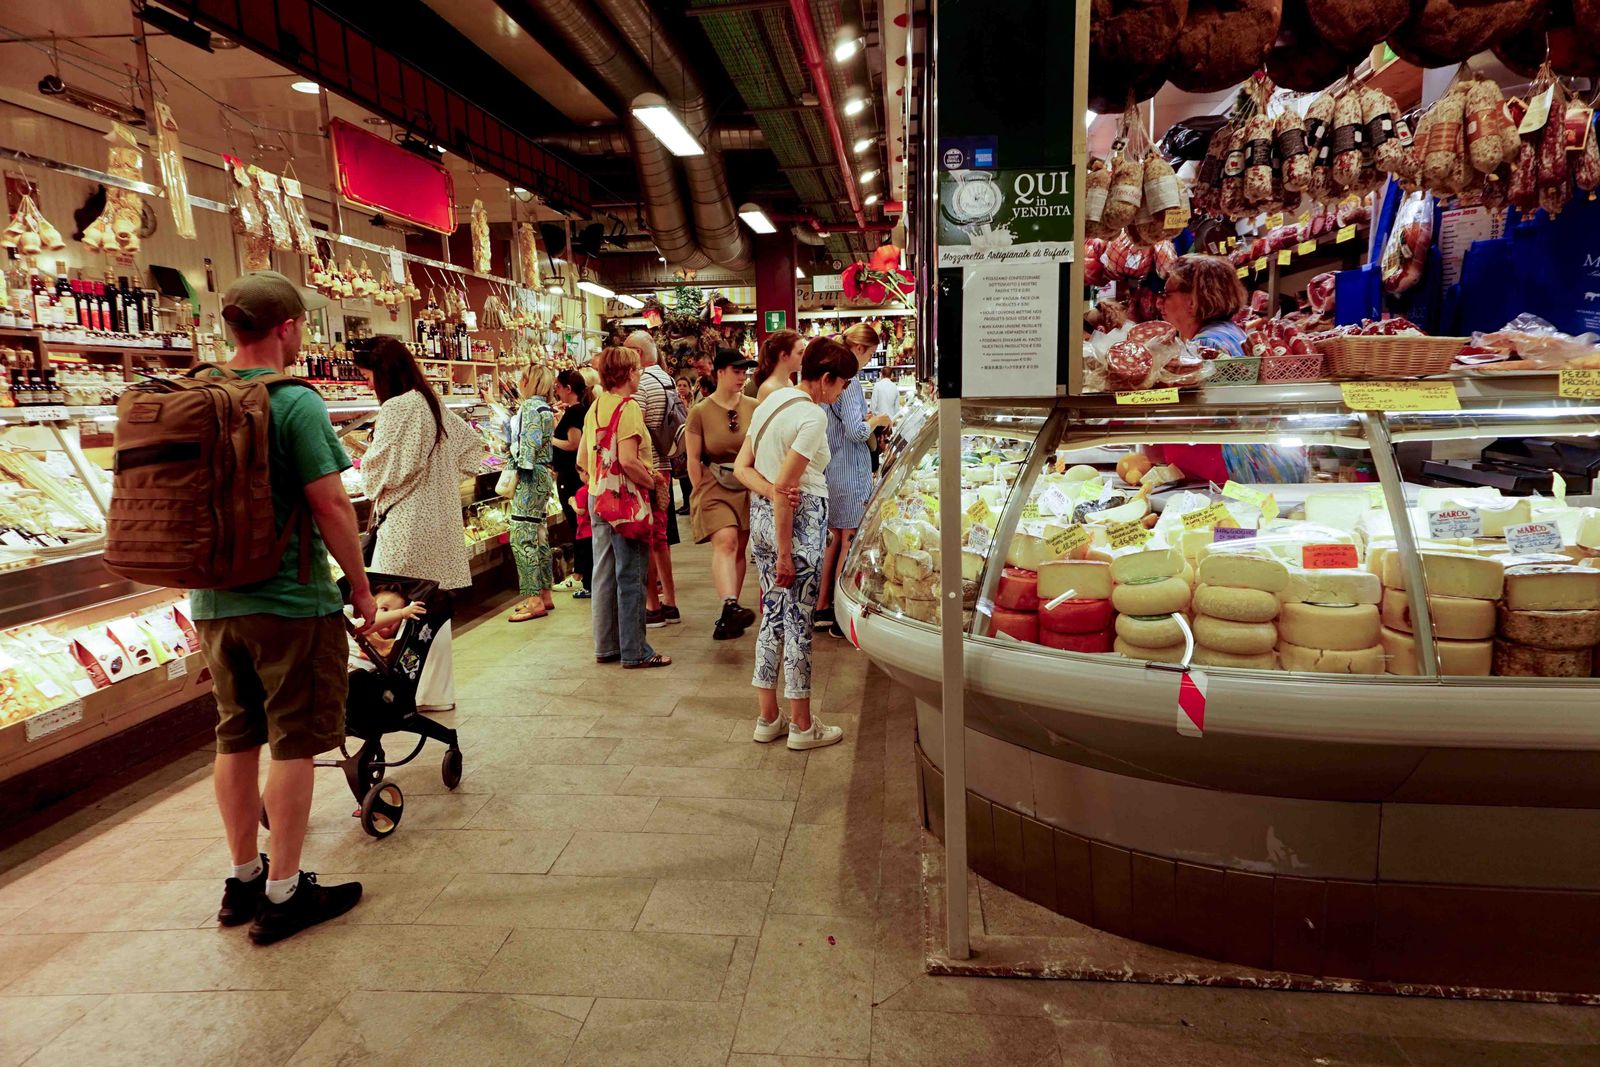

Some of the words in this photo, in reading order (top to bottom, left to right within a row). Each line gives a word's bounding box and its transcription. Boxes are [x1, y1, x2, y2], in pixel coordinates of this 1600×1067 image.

[1014, 171, 1069, 205] QUI
[1036, 196, 1047, 206] in
[1012, 205, 1072, 218] VENDITA
[941, 251, 985, 264] Mozzarella
[987, 248, 1031, 262] Artigianale
[1032, 249, 1042, 257] di
[1562, 370, 1590, 378] PEZZI
[1438, 510, 1468, 519] MARCO
[1516, 524, 1548, 534] MARCO
